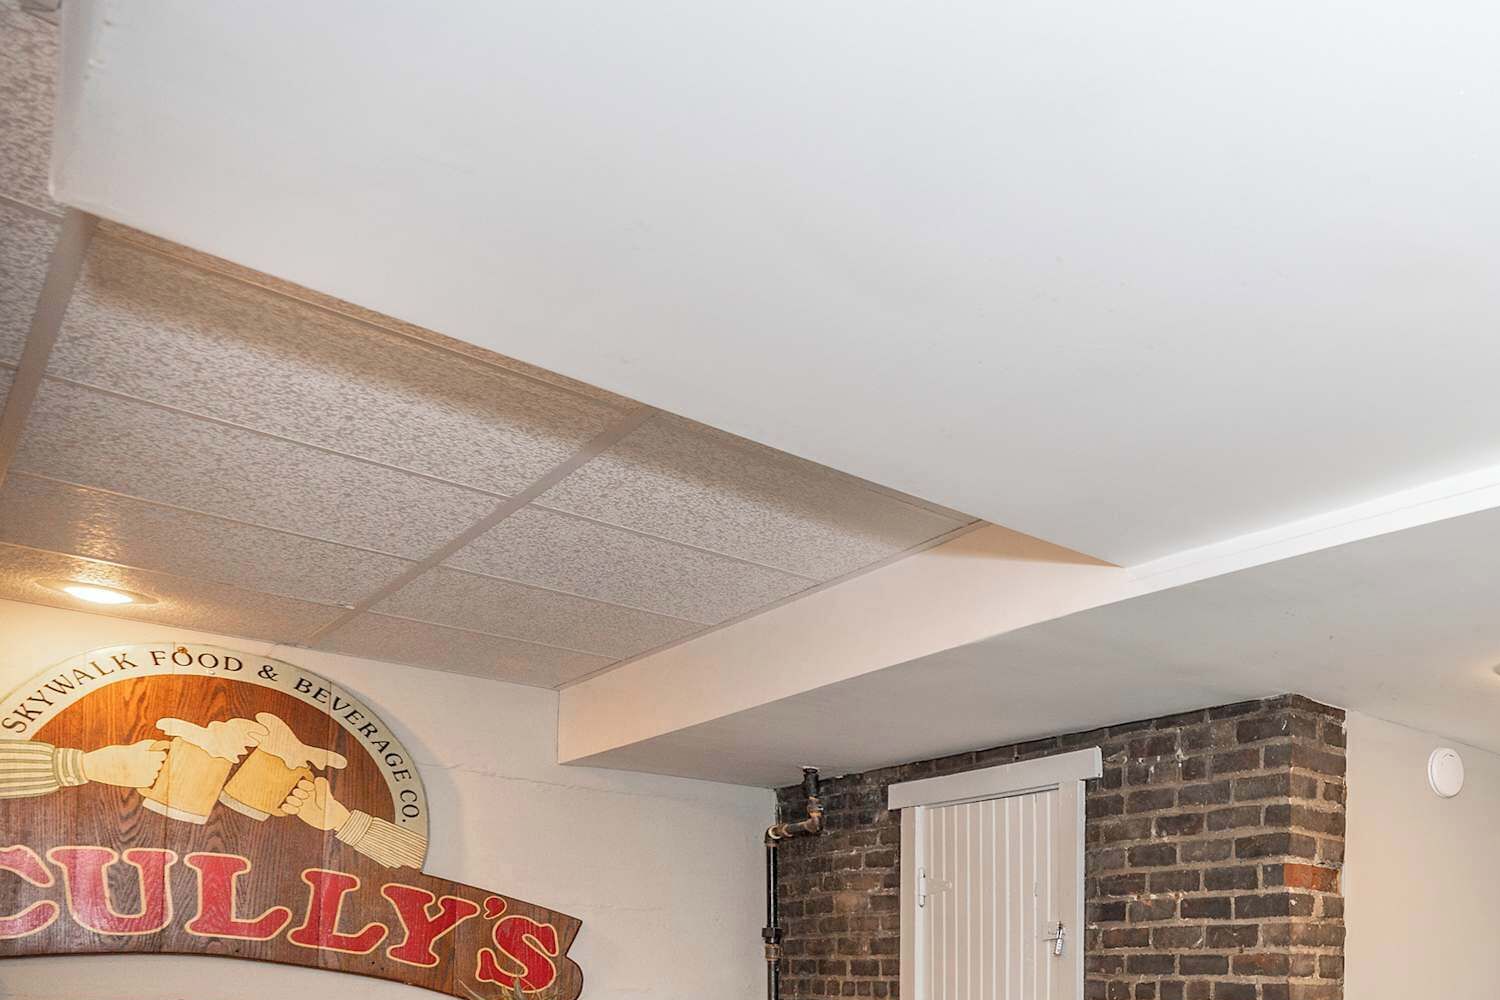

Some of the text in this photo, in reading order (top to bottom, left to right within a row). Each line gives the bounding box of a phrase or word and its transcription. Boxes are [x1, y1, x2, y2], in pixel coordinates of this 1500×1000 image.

[1, 649, 420, 823] SKYWALK FOOD & BEVERAGE CO.
